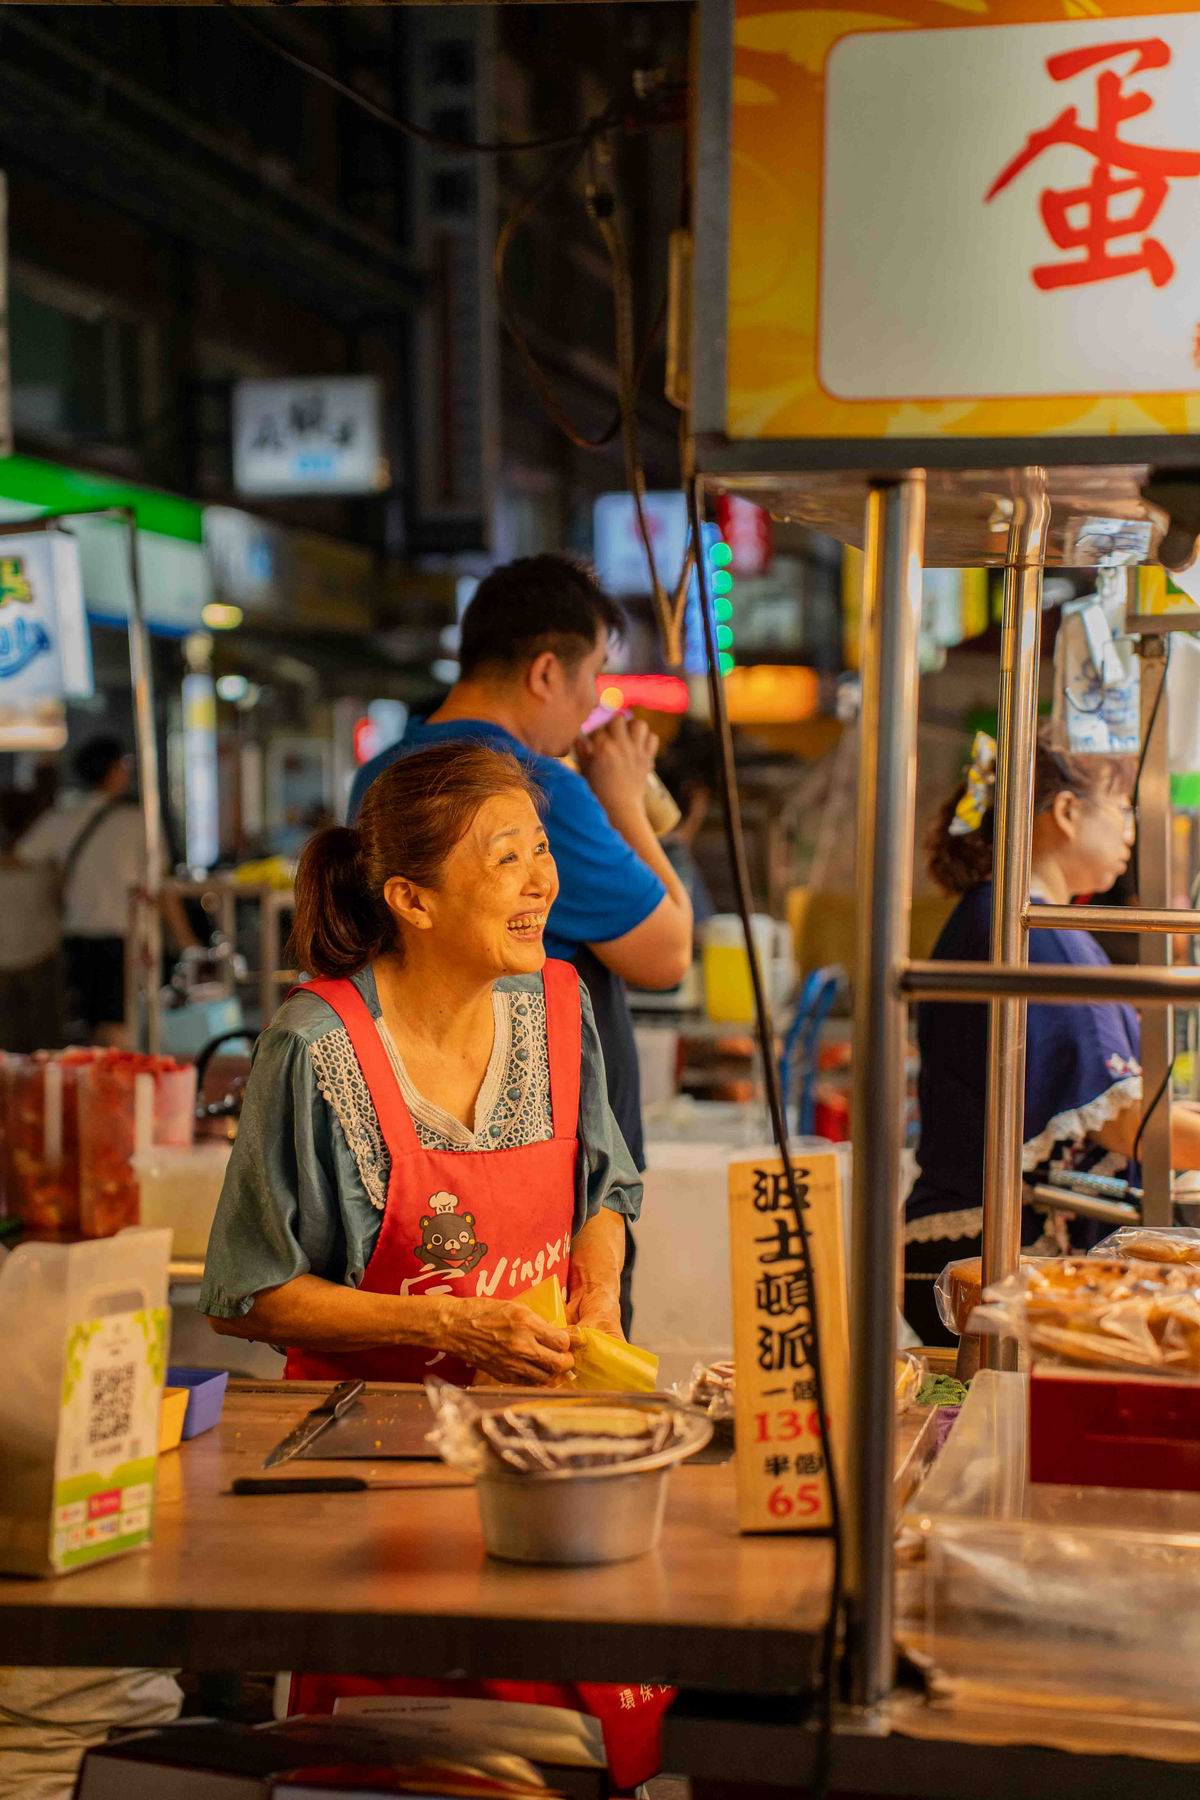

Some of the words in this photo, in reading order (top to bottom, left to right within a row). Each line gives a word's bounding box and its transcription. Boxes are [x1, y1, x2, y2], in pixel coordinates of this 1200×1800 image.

[983, 37, 1200, 292] 蛋
[753, 1167, 816, 1372] 波士頓派
[754, 1408, 832, 1443] 130
[767, 1483, 821, 1519] 65
